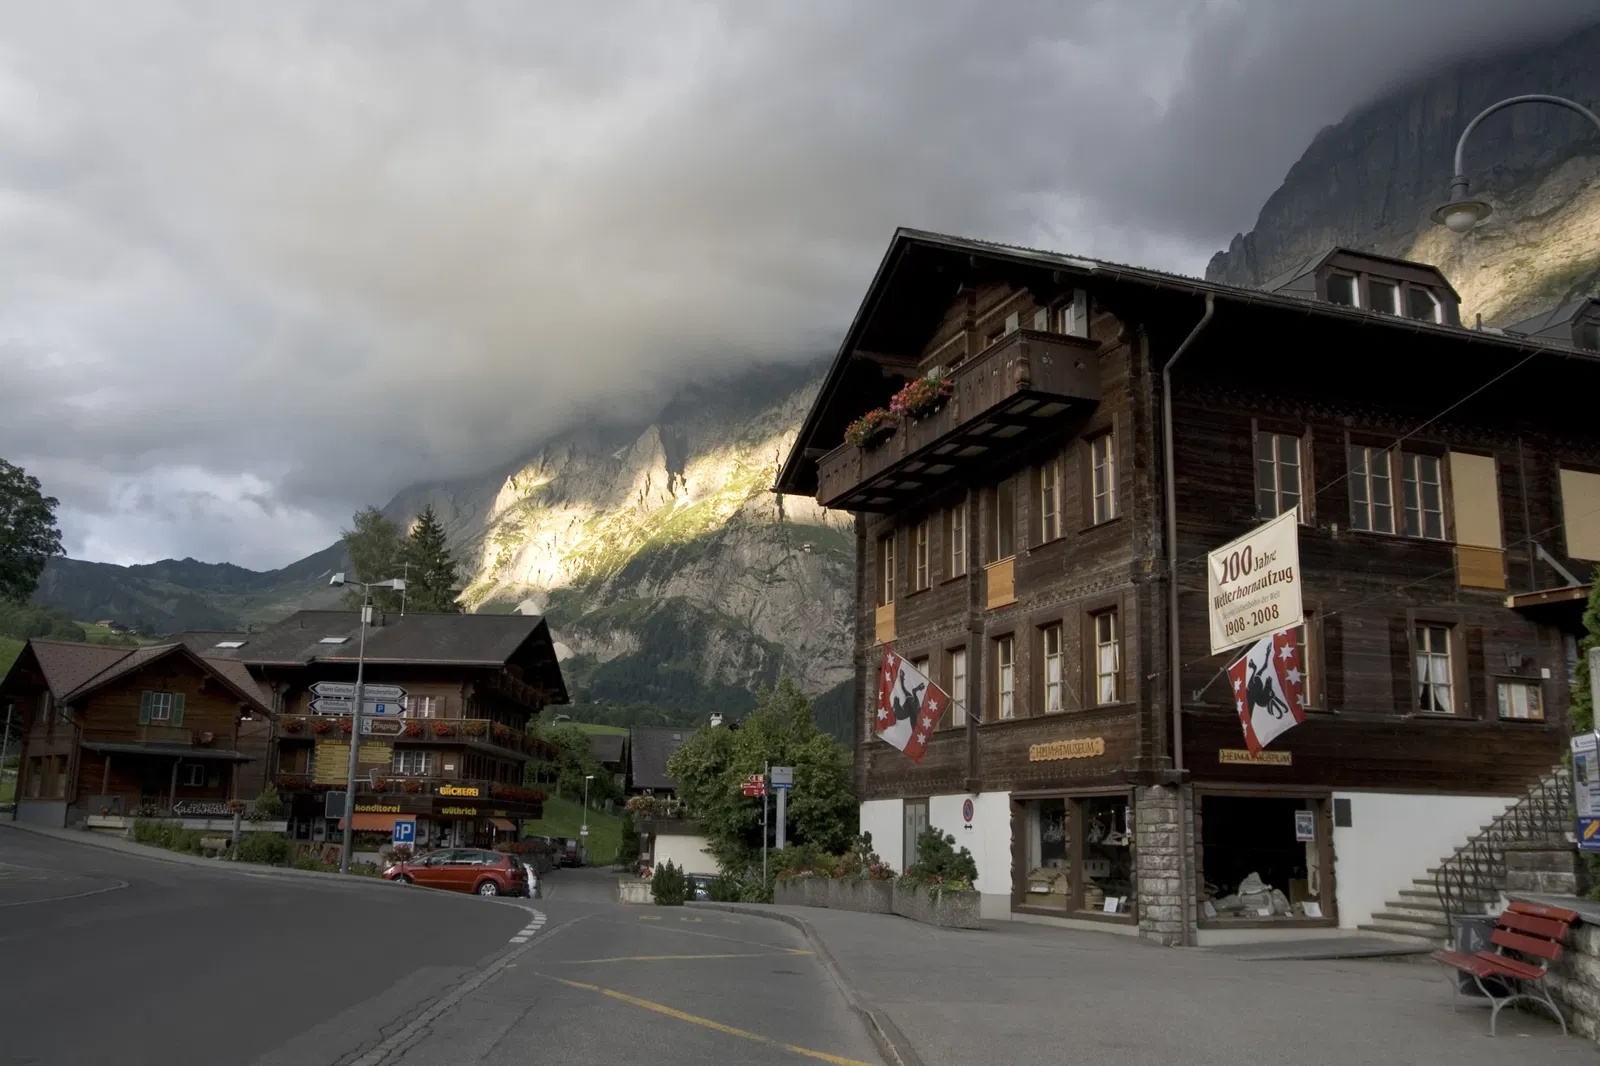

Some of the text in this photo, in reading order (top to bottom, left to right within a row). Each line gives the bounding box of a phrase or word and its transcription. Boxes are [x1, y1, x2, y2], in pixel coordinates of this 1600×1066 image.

[1219, 545, 1277, 586] 100 Jahre
[1214, 566, 1294, 610] Wetterhornaufzug
[1225, 617, 1246, 637] 1908
[1251, 604, 1279, 627] 2008
[1036, 741, 1094, 758] HEIMATMUSEUM
[1223, 752, 1290, 763] HEIMAMUSEUM
[355, 804, 400, 813] konditorei
[400, 824, 411, 839] P
